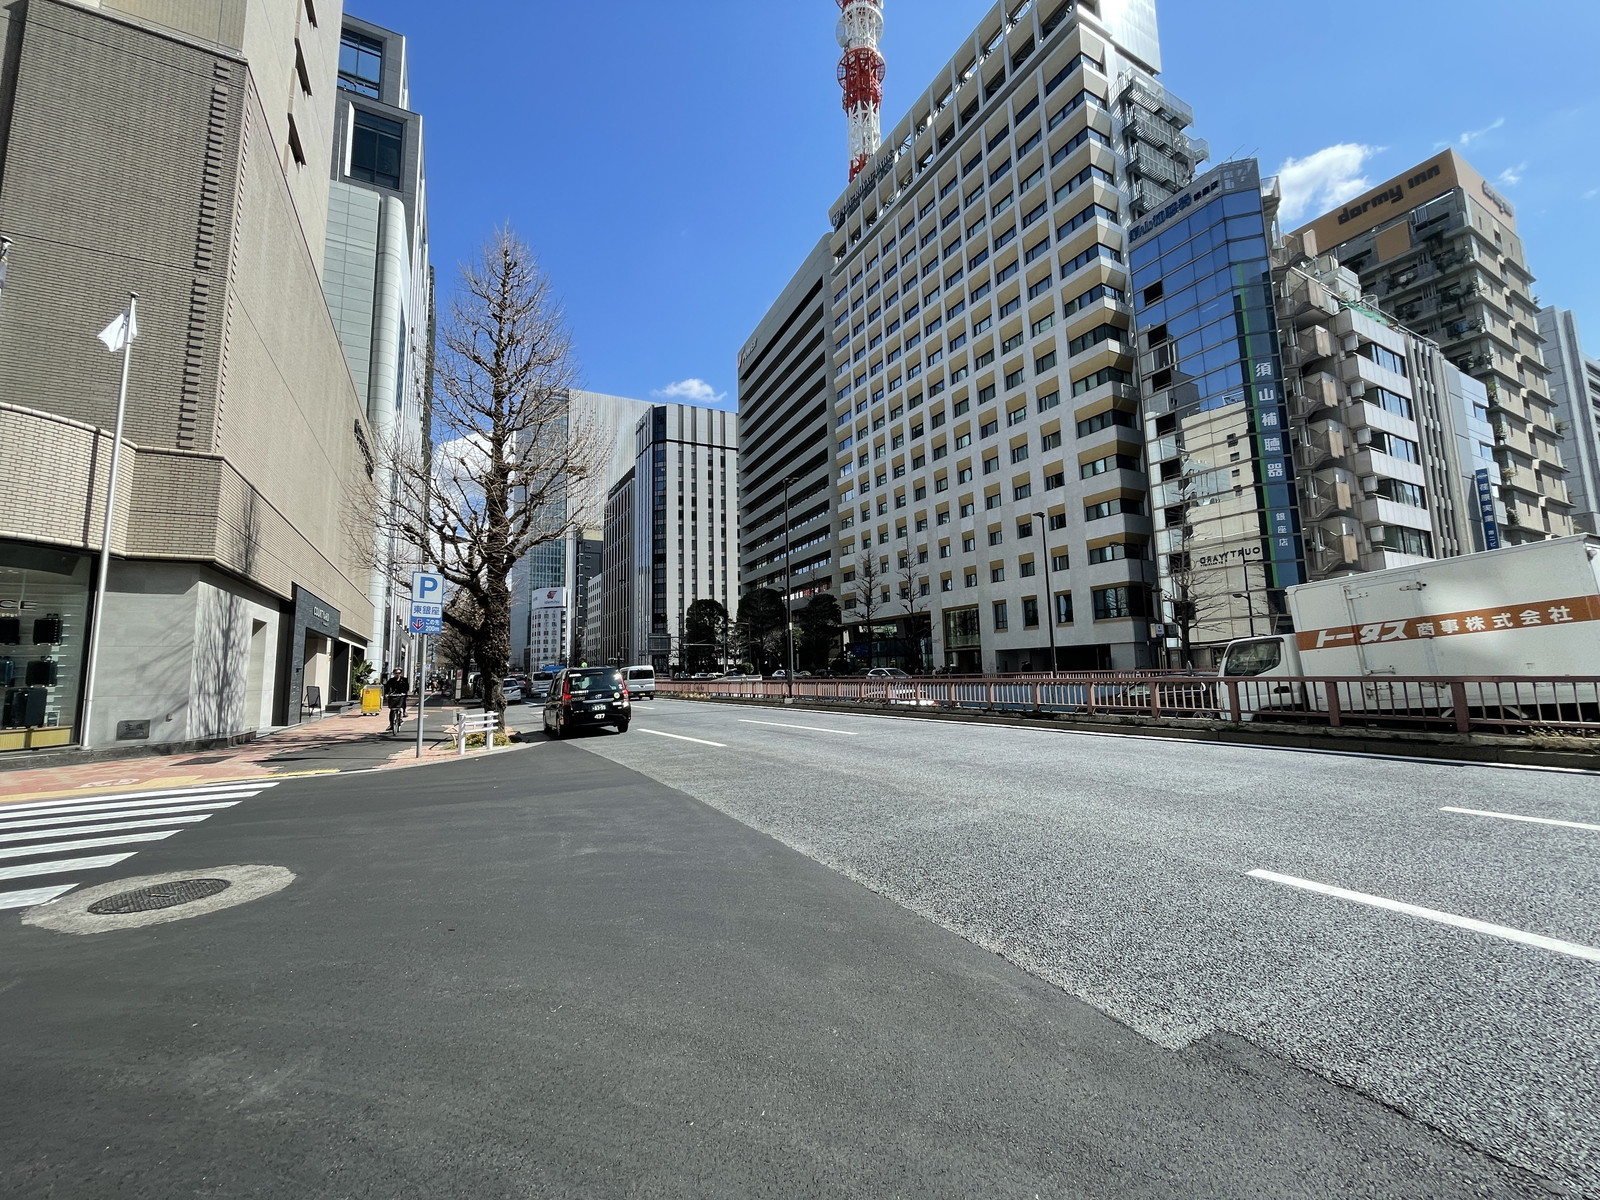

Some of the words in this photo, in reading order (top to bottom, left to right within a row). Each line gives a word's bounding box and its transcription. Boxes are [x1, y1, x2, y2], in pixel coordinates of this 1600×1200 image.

[1337, 184, 1404, 225] dormy
[1407, 164, 1441, 190] inn
[1255, 361, 1284, 478] 須山補聴器
[1275, 511, 1289, 547] 銀座店
[419, 576, 438, 599] P
[413, 605, 440, 616] 東銀座
[425, 618, 440, 626] この先
